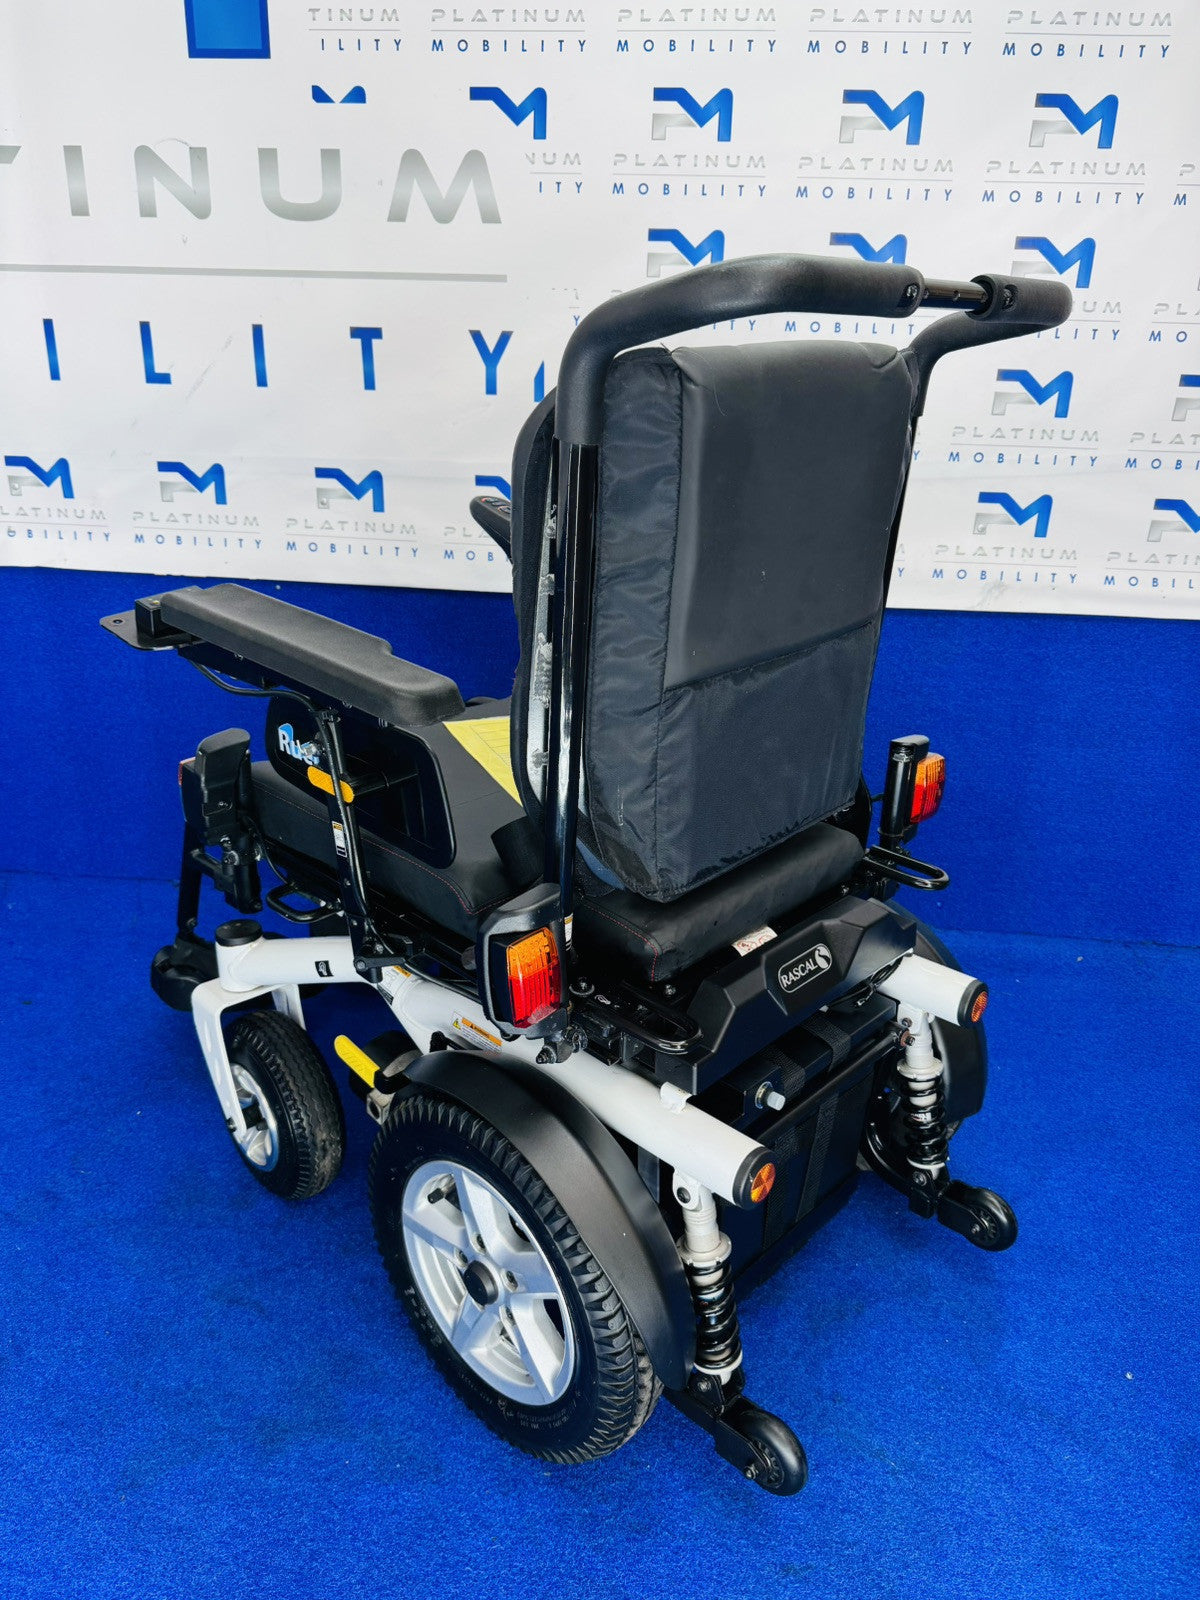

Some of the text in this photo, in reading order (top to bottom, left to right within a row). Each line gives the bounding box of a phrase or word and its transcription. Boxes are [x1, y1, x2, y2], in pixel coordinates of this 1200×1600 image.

[431, 9, 585, 22] PLATINUM
[618, 8, 775, 22] PLATINUM
[810, 9, 972, 23] PLATINUM
[1007, 11, 1171, 26] PLATINUM
[431, 39, 585, 54] MOBILITY
[616, 39, 775, 54] MOBILITY
[807, 41, 970, 55] MOBILITY
[1003, 44, 1169, 60] MOBILITY
[614, 154, 765, 168] PLATINUM
[799, 157, 953, 172] PLATINUM
[987, 161, 1145, 175] PLATINUM
[0, 145, 502, 224] INUM
[612, 183, 765, 198] MOBILITY
[795, 187, 951, 201] MOBILITY
[982, 191, 1142, 205] MOBILITY
[784, 320, 914, 336] MOBILIT
[952, 426, 1099, 442] PLATINUM
[948, 452, 1097, 466] MOBILITY
[133, 511, 260, 527] PLATINUM
[286, 518, 417, 535] PLATINUM
[134, 534, 262, 549] MOBILITY
[286, 542, 418, 558] MOBILITY
[935, 544, 1077, 560] PLATINUM
[932, 569, 1077, 584] MOBILITY
[782, 958, 818, 988] RASCAL
